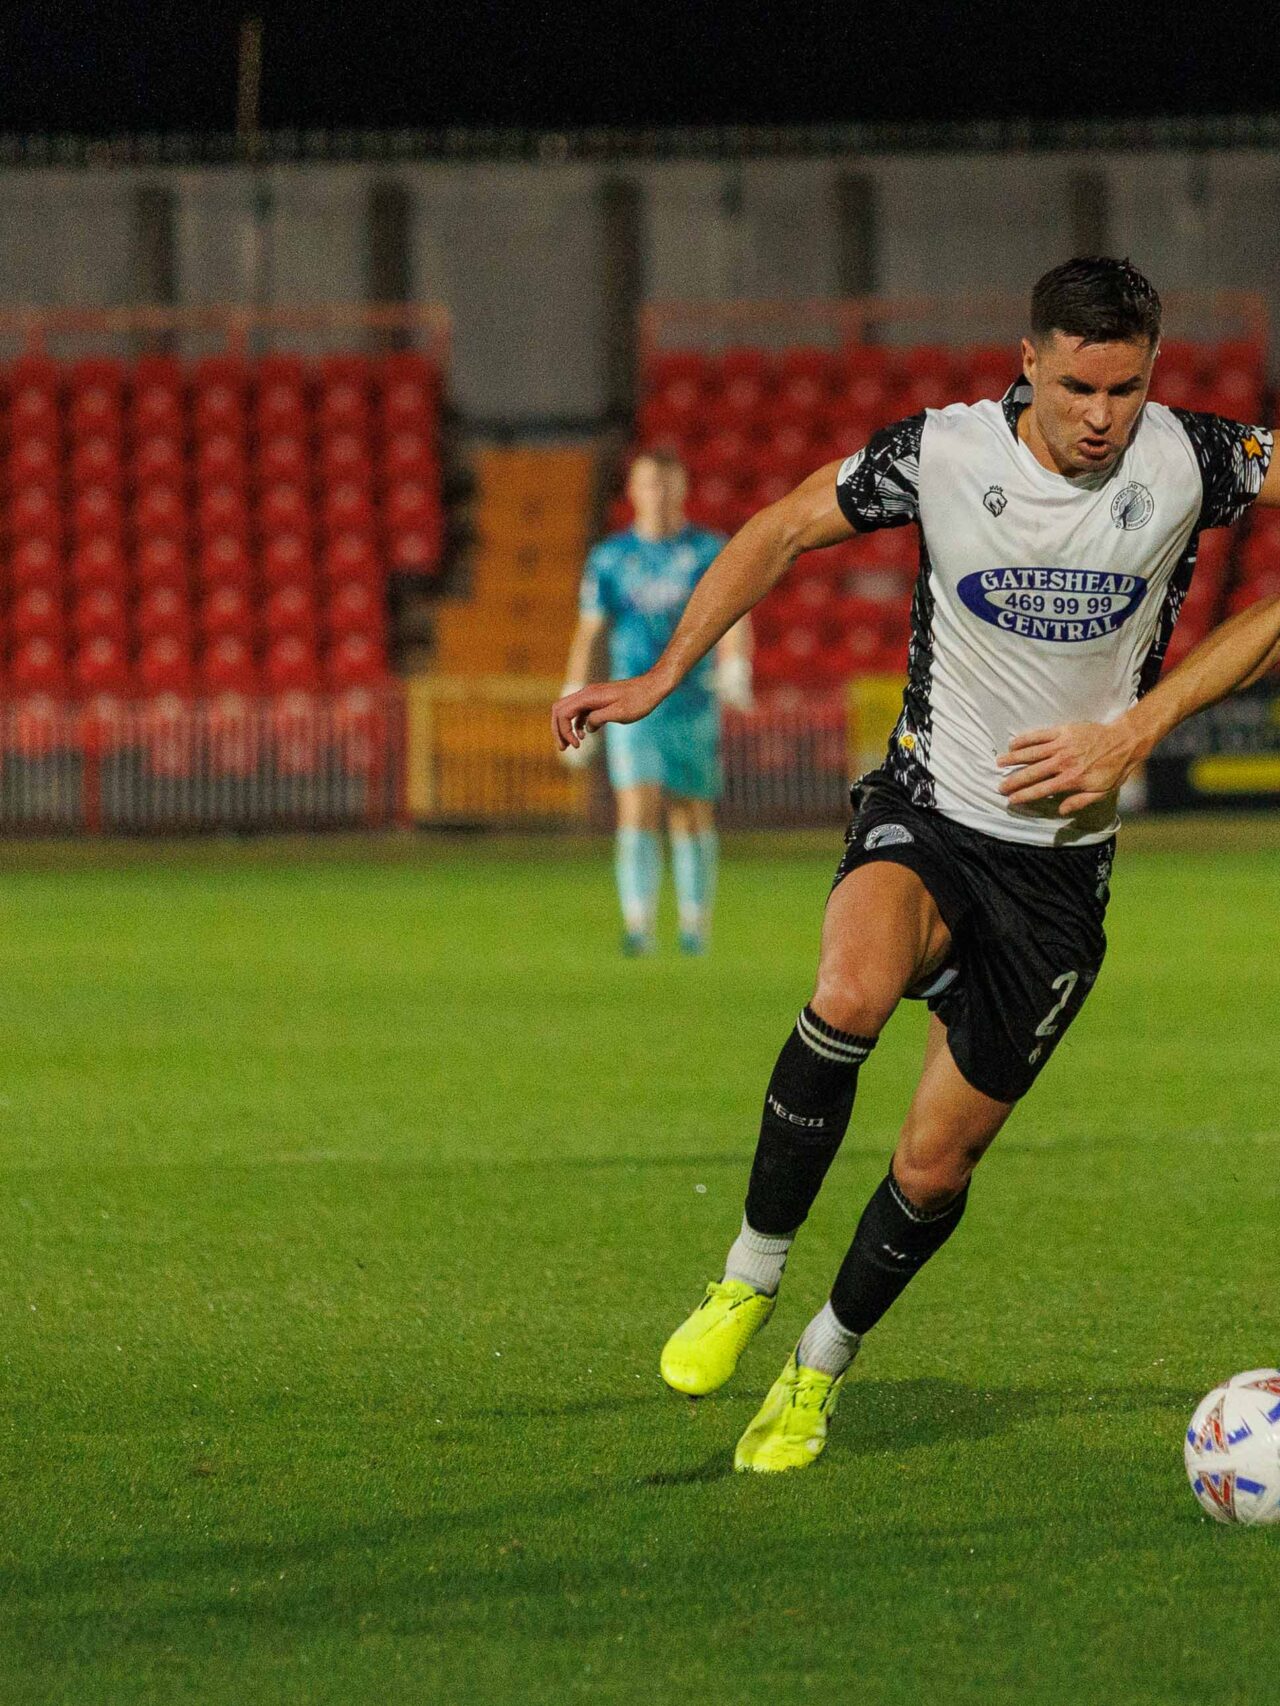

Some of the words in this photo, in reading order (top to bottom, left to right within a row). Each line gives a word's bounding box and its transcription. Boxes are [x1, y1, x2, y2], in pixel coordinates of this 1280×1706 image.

[980, 569, 1136, 594] GATESHEAD
[1005, 593, 1045, 613] 469
[1053, 597, 1079, 615] 99
[1087, 596, 1112, 614] 99
[997, 610, 1118, 640] CENTRAL
[1035, 971, 1079, 1036] 2
